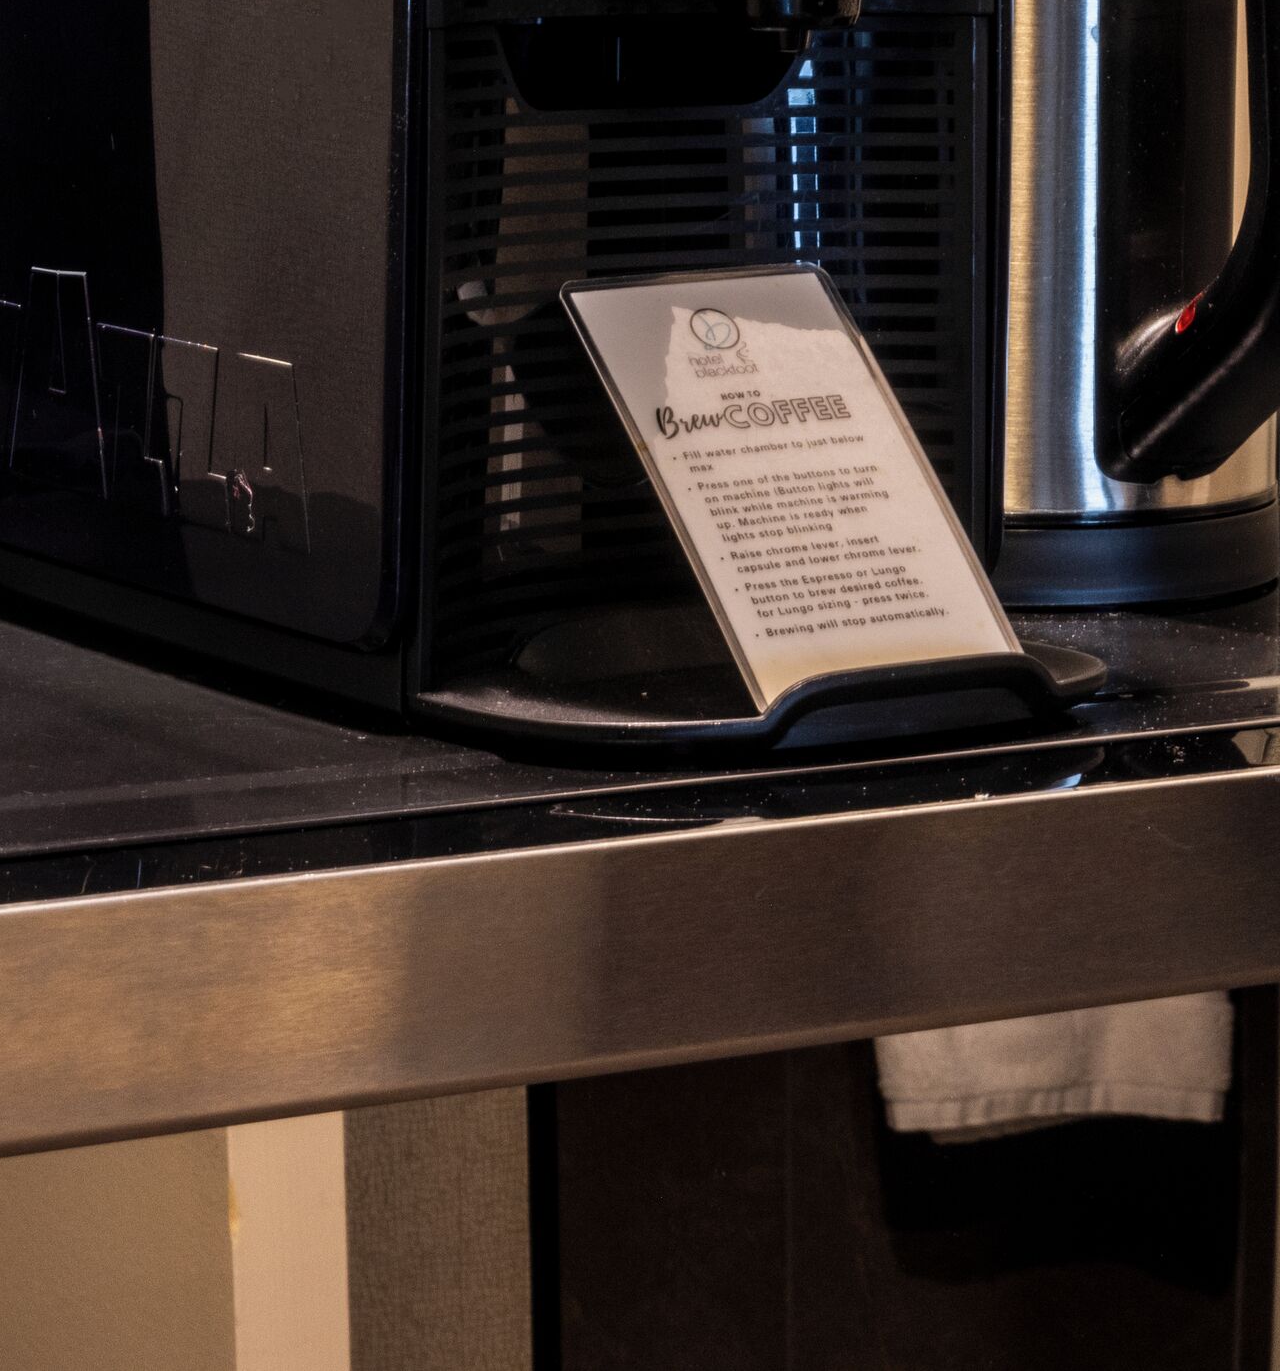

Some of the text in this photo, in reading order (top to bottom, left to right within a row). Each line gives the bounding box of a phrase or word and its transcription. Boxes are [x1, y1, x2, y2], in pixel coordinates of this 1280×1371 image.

[688, 354, 723, 366] hotel
[695, 363, 759, 378] blackfoot
[721, 390, 760, 400] HOW TO
[656, 394, 851, 439] Brew COFFEE
[683, 434, 864, 460] Fill water chamber to just below
[689, 463, 713, 473] max
[698, 464, 877, 491] Press one of the buttons to turn
[710, 489, 889, 516] blink while machine is warming
[723, 489, 770, 502] machine
[774, 485, 815, 496] (Button
[819, 481, 850, 492] lights
[854, 478, 874, 487] will
[717, 505, 868, 530] up. Machine is ready when
[722, 521, 833, 543] lights stop blinking
[730, 550, 762, 561] Raise
[766, 544, 808, 556] chrome
[847, 535, 879, 546] insert
[737, 544, 921, 574] capsule and lower chrome lever.
[745, 564, 906, 591] Press the Espresso or Lungo
[751, 593, 789, 605] button
[793, 591, 805, 599] to
[809, 586, 836, 597] brew
[840, 580, 881, 593] desired
[757, 608, 774, 618] for
[778, 603, 813, 616] Lungo
[818, 598, 851, 611] sizing
[863, 596, 892, 608] press
[895, 590, 929, 601] twice.
[765, 605, 949, 638] Brewing will stop automatically.
